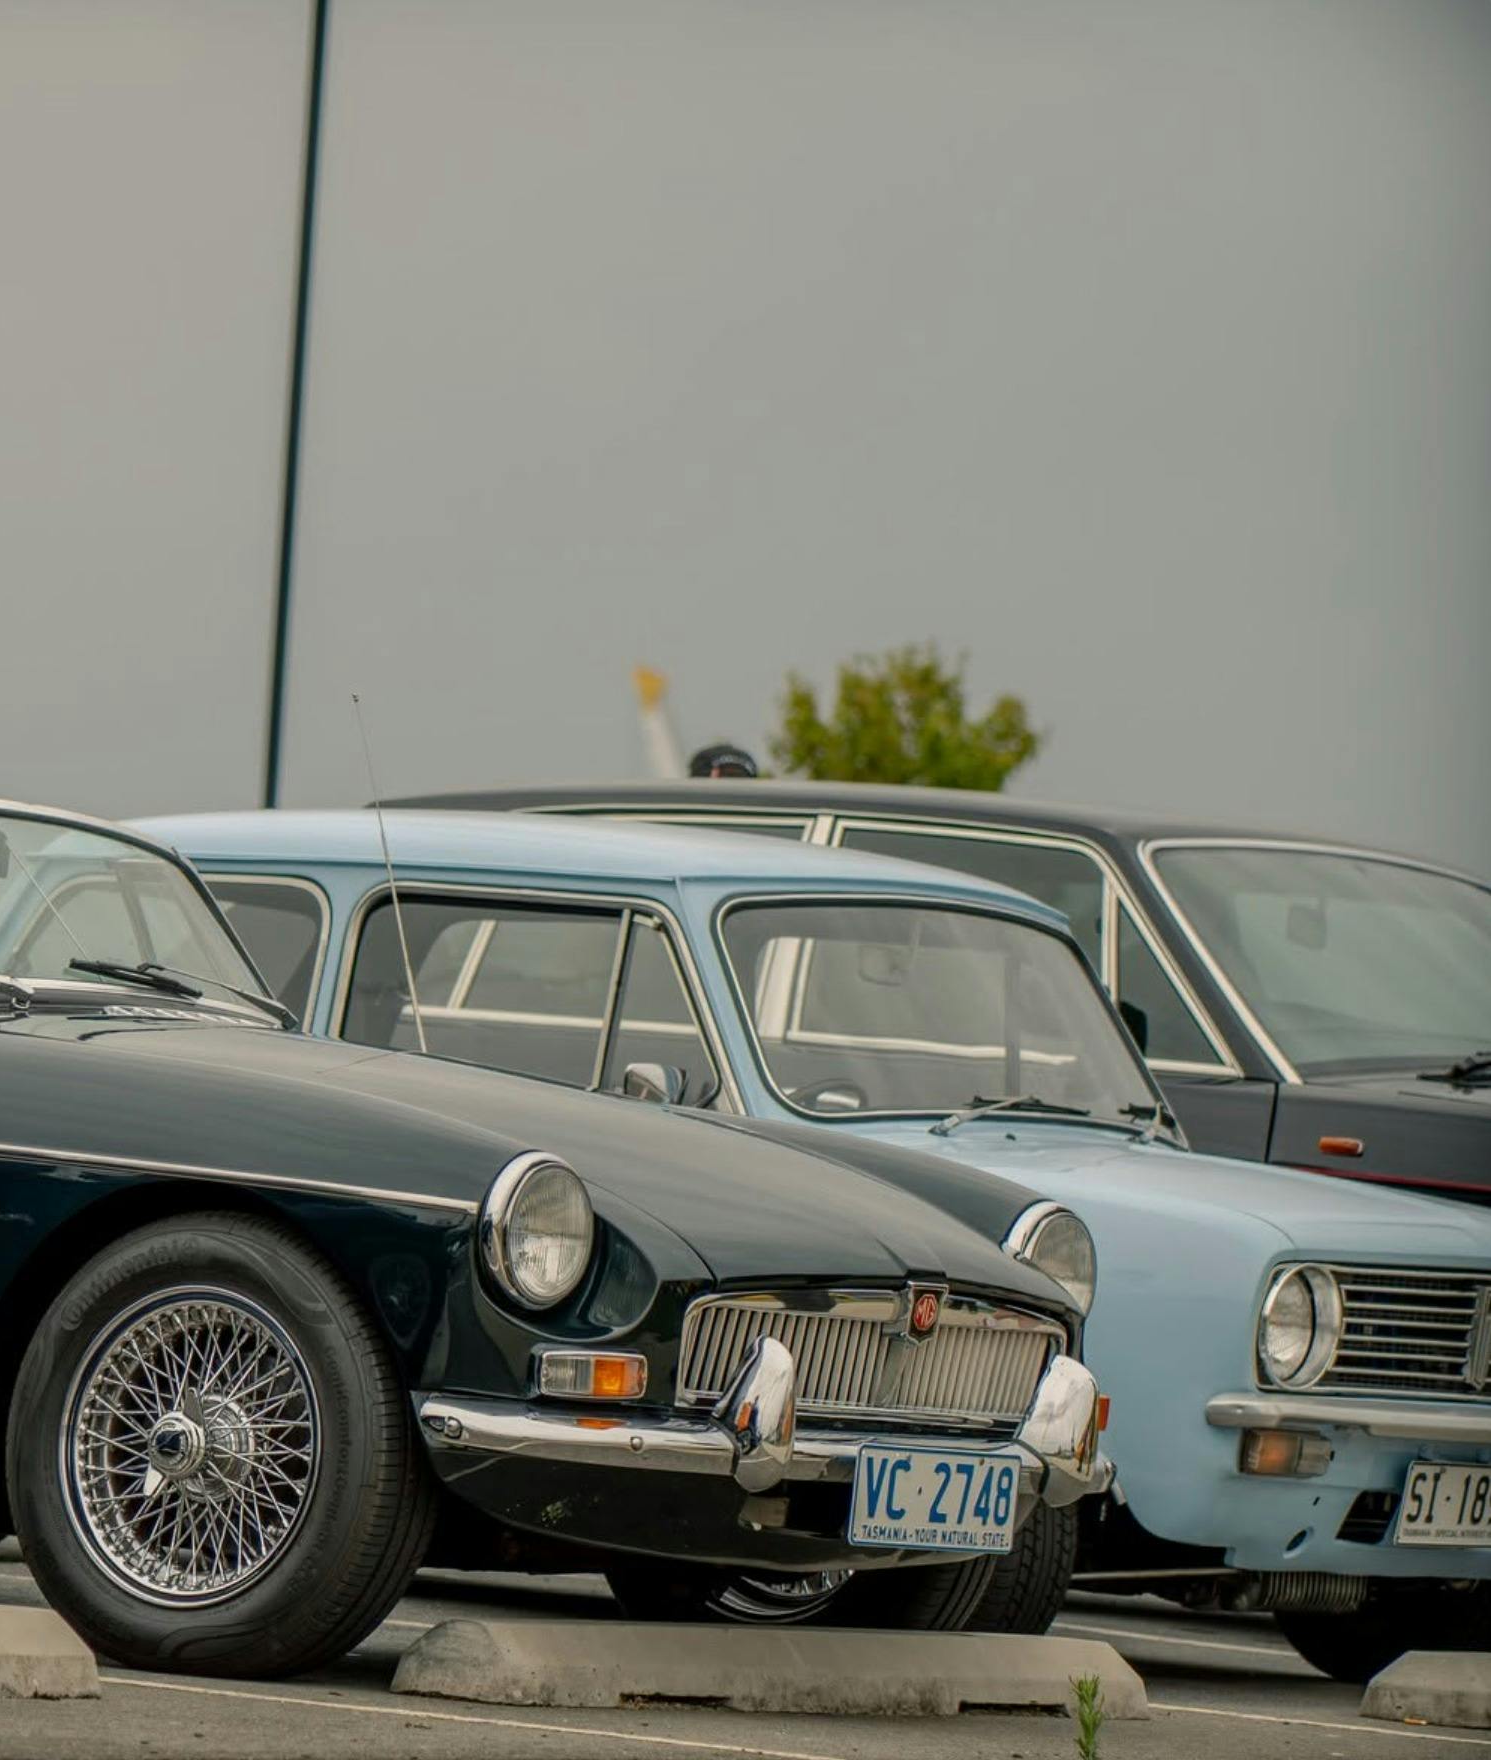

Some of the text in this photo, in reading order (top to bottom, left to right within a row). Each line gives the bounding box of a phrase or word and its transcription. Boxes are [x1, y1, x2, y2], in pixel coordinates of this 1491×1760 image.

[915, 1297, 937, 1327] MG
[867, 1456, 1013, 1527] VC 2748
[1406, 1472, 1491, 1525] SI 18
[941, 1530, 978, 1545] NATURAL
